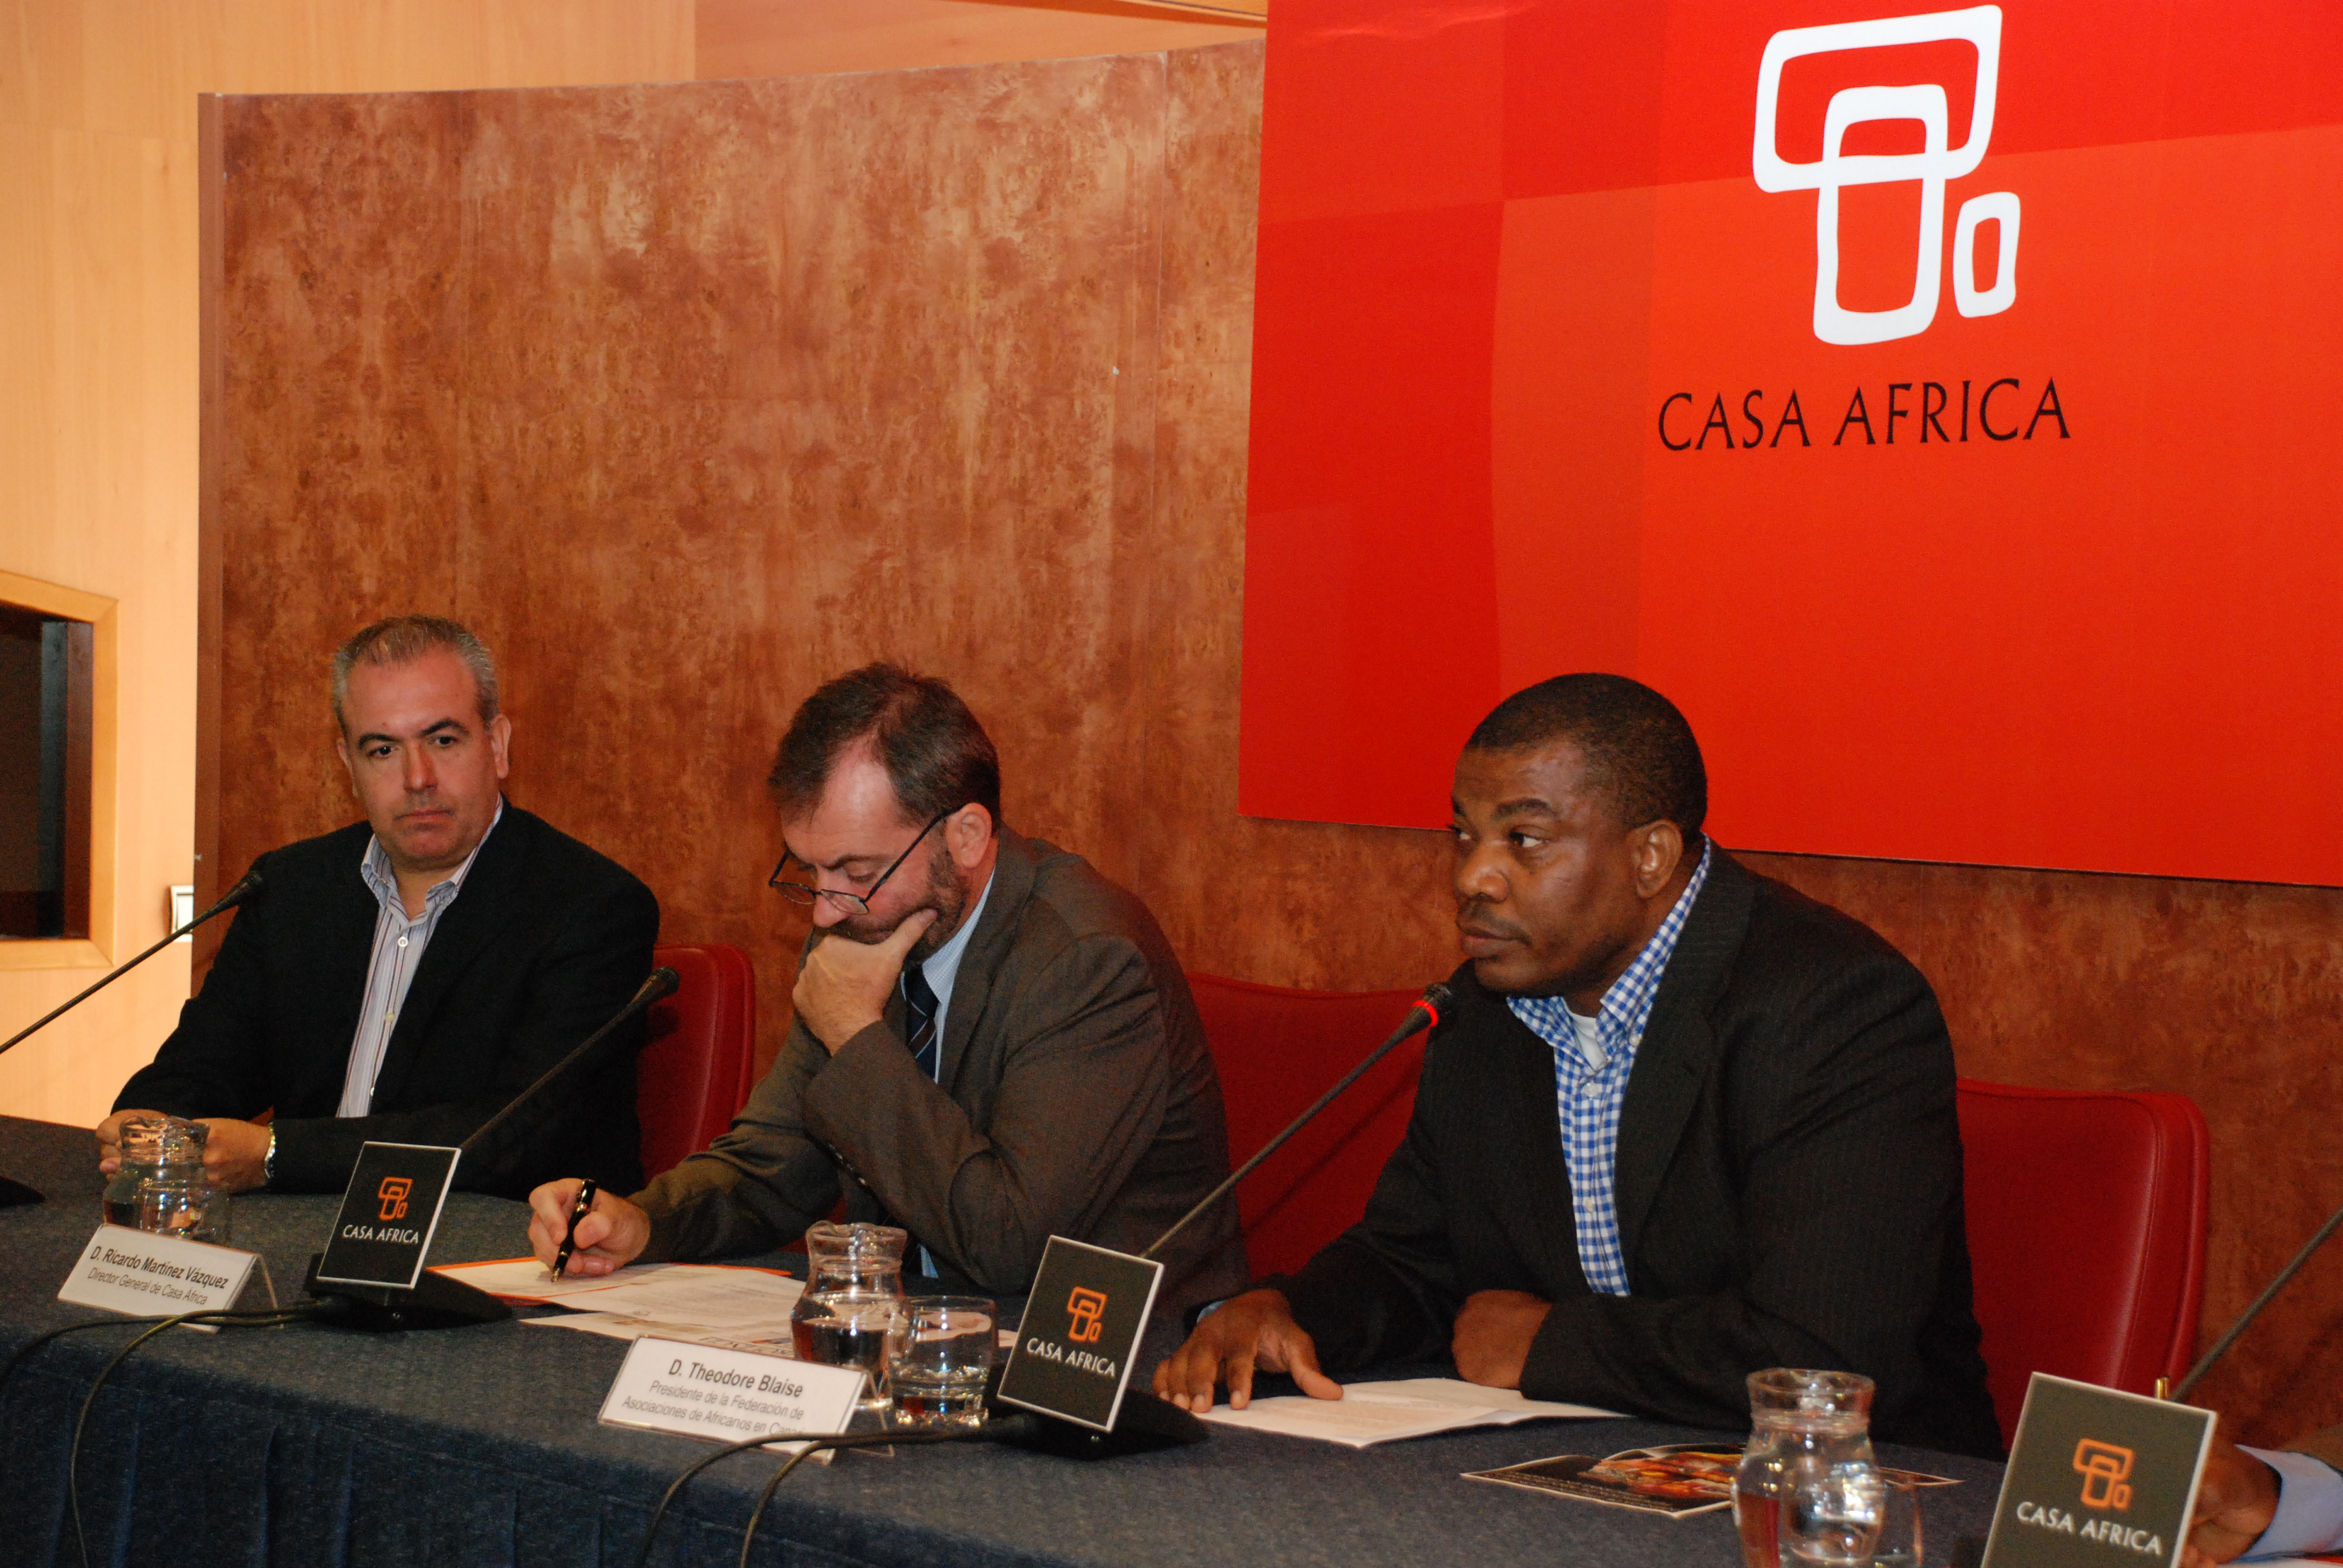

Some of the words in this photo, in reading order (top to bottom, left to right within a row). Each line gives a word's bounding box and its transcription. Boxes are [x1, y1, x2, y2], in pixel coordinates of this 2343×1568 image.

[1658, 388, 1811, 451] CASA
[1832, 376, 2071, 446] AFRICA
[342, 1224, 373, 1240] CASA
[376, 1227, 419, 1244] AFRICA
[87, 1267, 119, 1284] Director
[119, 1274, 151, 1291] General
[149, 1282, 162, 1294] de
[162, 1284, 183, 1300] Casa
[90, 1246, 102, 1260] D.
[102, 1249, 141, 1269] Ricardo
[141, 1256, 185, 1279] Martínez
[185, 1266, 229, 1289] Vázquez
[668, 1358, 683, 1377] D.
[689, 1362, 755, 1389] Theodore
[758, 1374, 803, 1397] Blaise
[1026, 1337, 1061, 1361] CASA
[1065, 1350, 1116, 1378] AFRICA
[621, 1395, 688, 1419] Asociaciones
[689, 1408, 703, 1422] de
[703, 1410, 753, 1431] Africanos
[753, 1421, 767, 1434] en
[649, 1380, 703, 1402] Presidente
[704, 1390, 718, 1404] de
[719, 1393, 729, 1406] la
[730, 1394, 788, 1417] Federación
[790, 1406, 804, 1420] de
[2016, 1501, 2075, 1537] CASA
[2079, 1518, 2163, 1556] AFRICA
